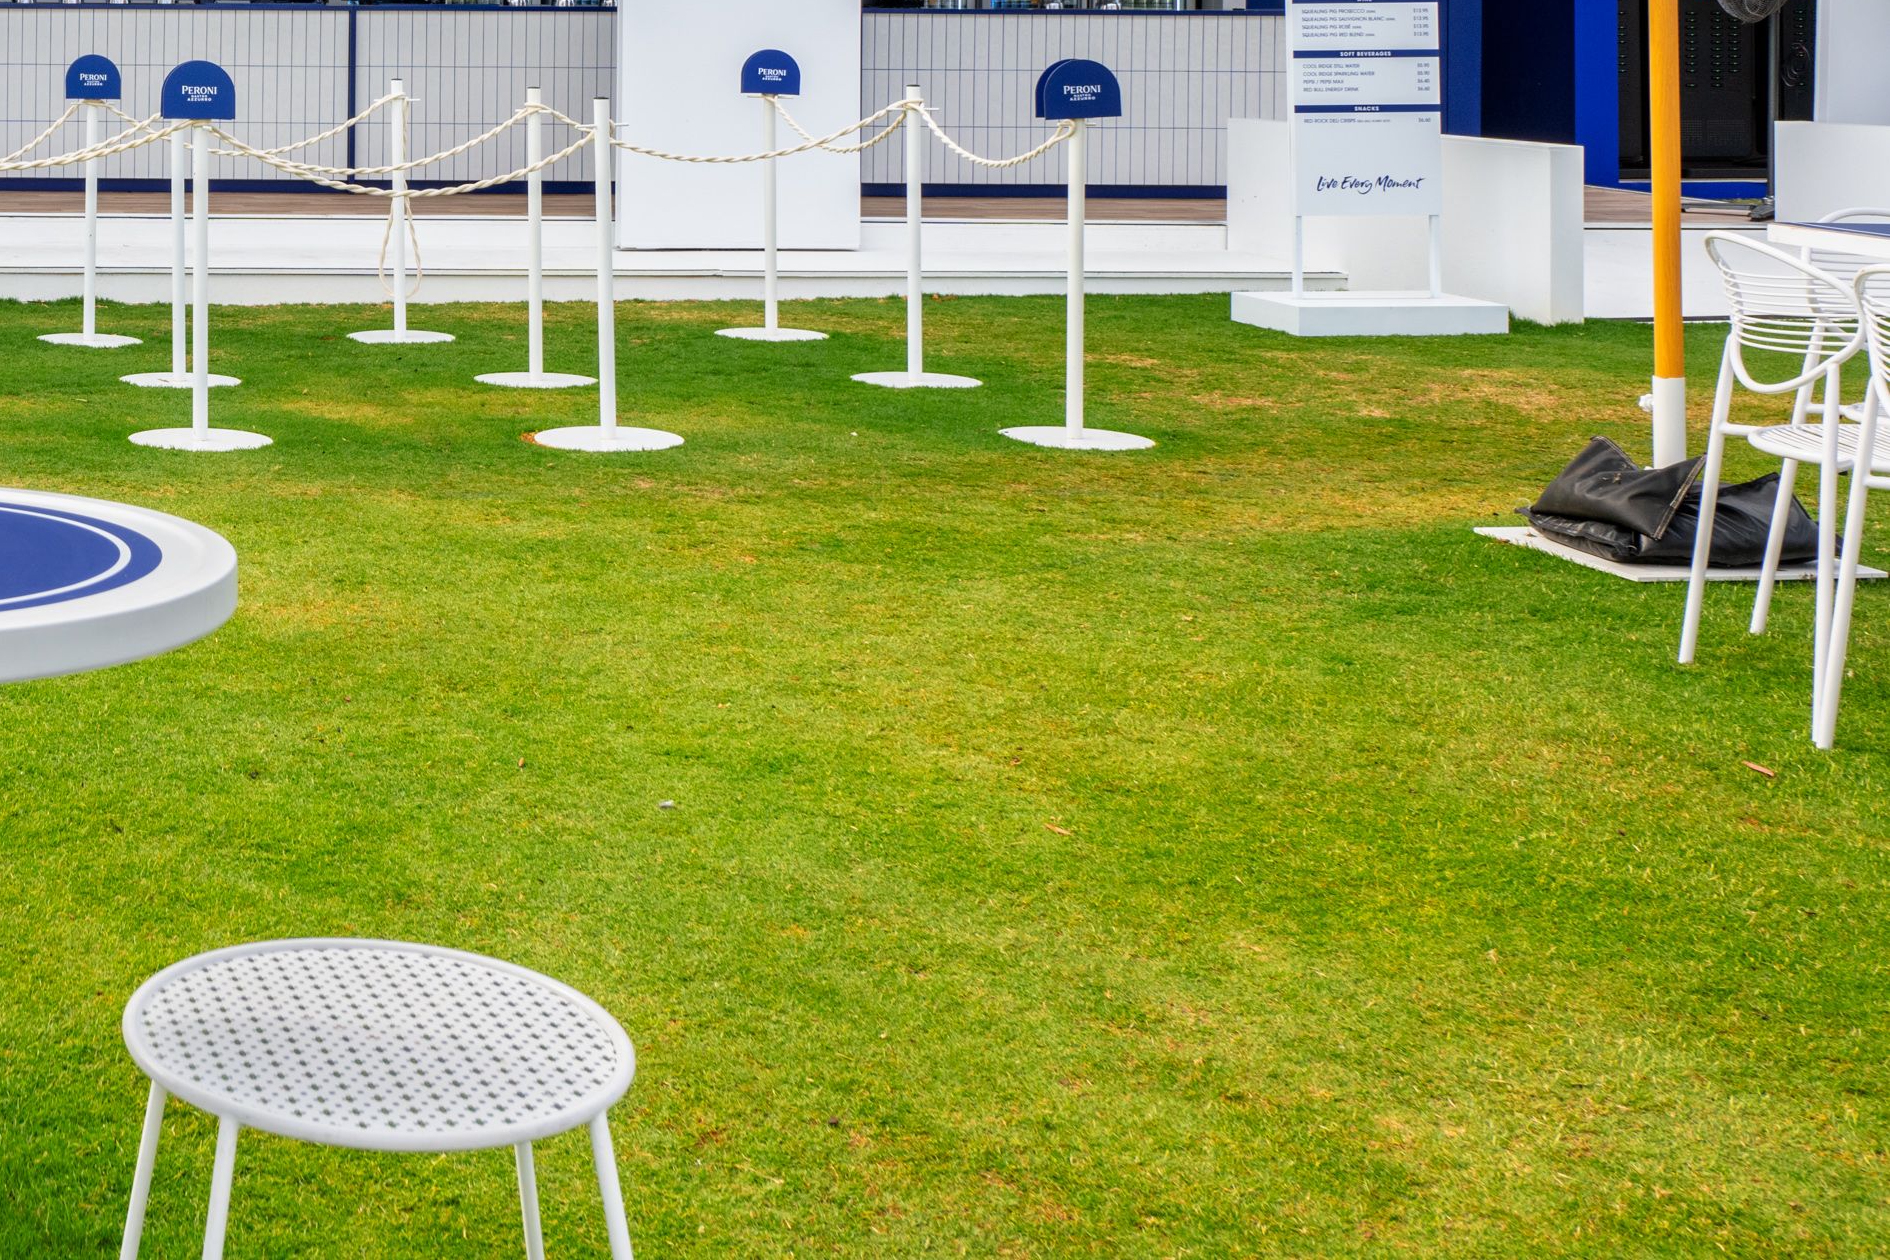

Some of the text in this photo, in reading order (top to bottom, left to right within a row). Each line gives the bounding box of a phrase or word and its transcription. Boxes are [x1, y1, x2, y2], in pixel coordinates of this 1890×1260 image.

[758, 68, 787, 76] PERONI
[182, 86, 217, 95] PERONI
[1063, 85, 1101, 95] PERONI
[1317, 175, 1426, 195] Live Every Moment
